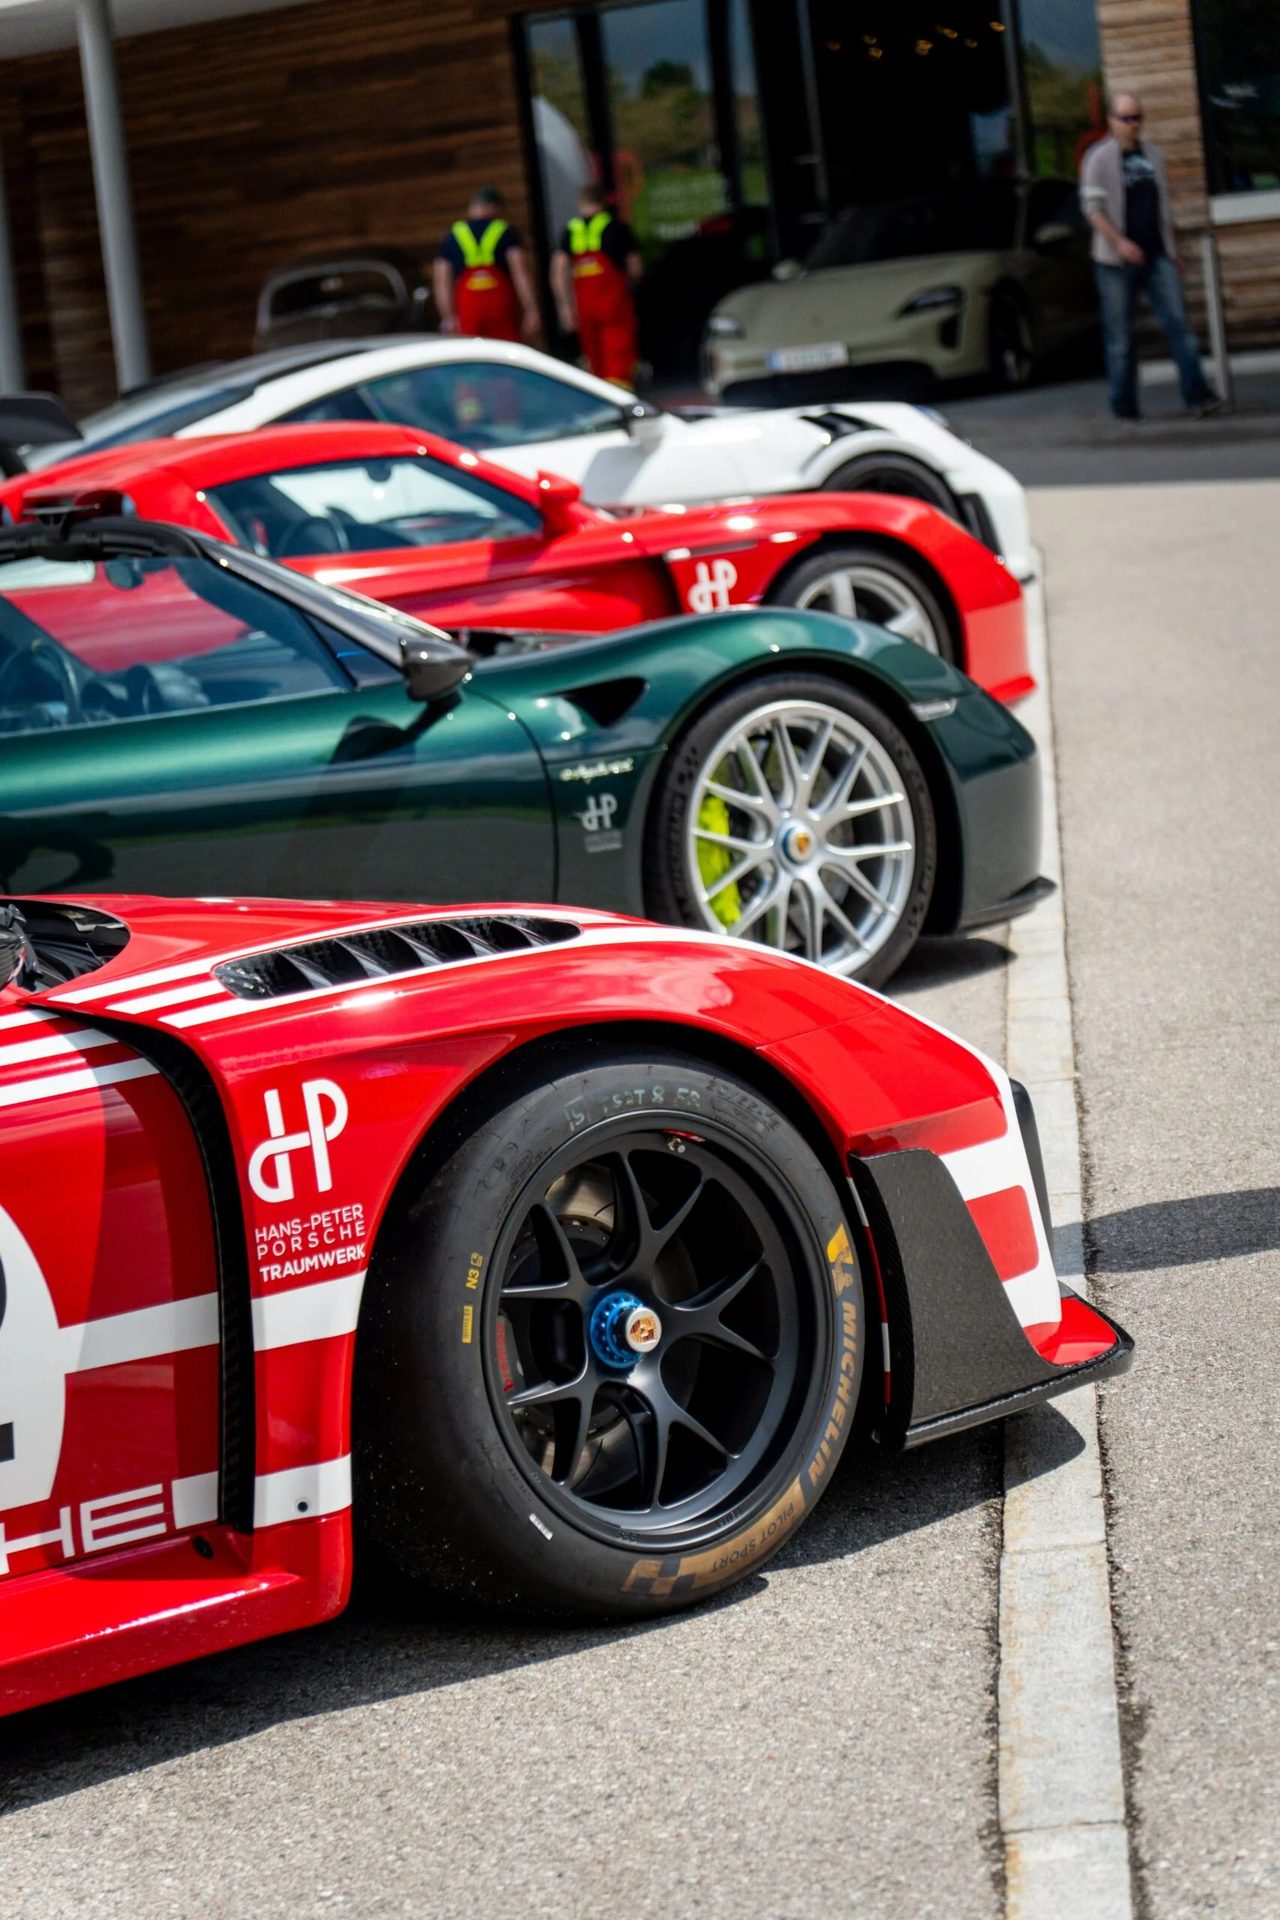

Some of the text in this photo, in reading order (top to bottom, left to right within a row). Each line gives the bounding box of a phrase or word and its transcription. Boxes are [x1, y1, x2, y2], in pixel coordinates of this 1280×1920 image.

[254, 1203, 364, 1244] HANS-PETER
[257, 1220, 367, 1261] PORSCHE
[259, 1242, 366, 1283] TRAUMWERK
[465, 1268, 480, 1290] N3
[807, 1301, 857, 1487] MICHELIN
[760, 1502, 794, 1544] PILOT
[710, 1541, 757, 1574] SPORT
